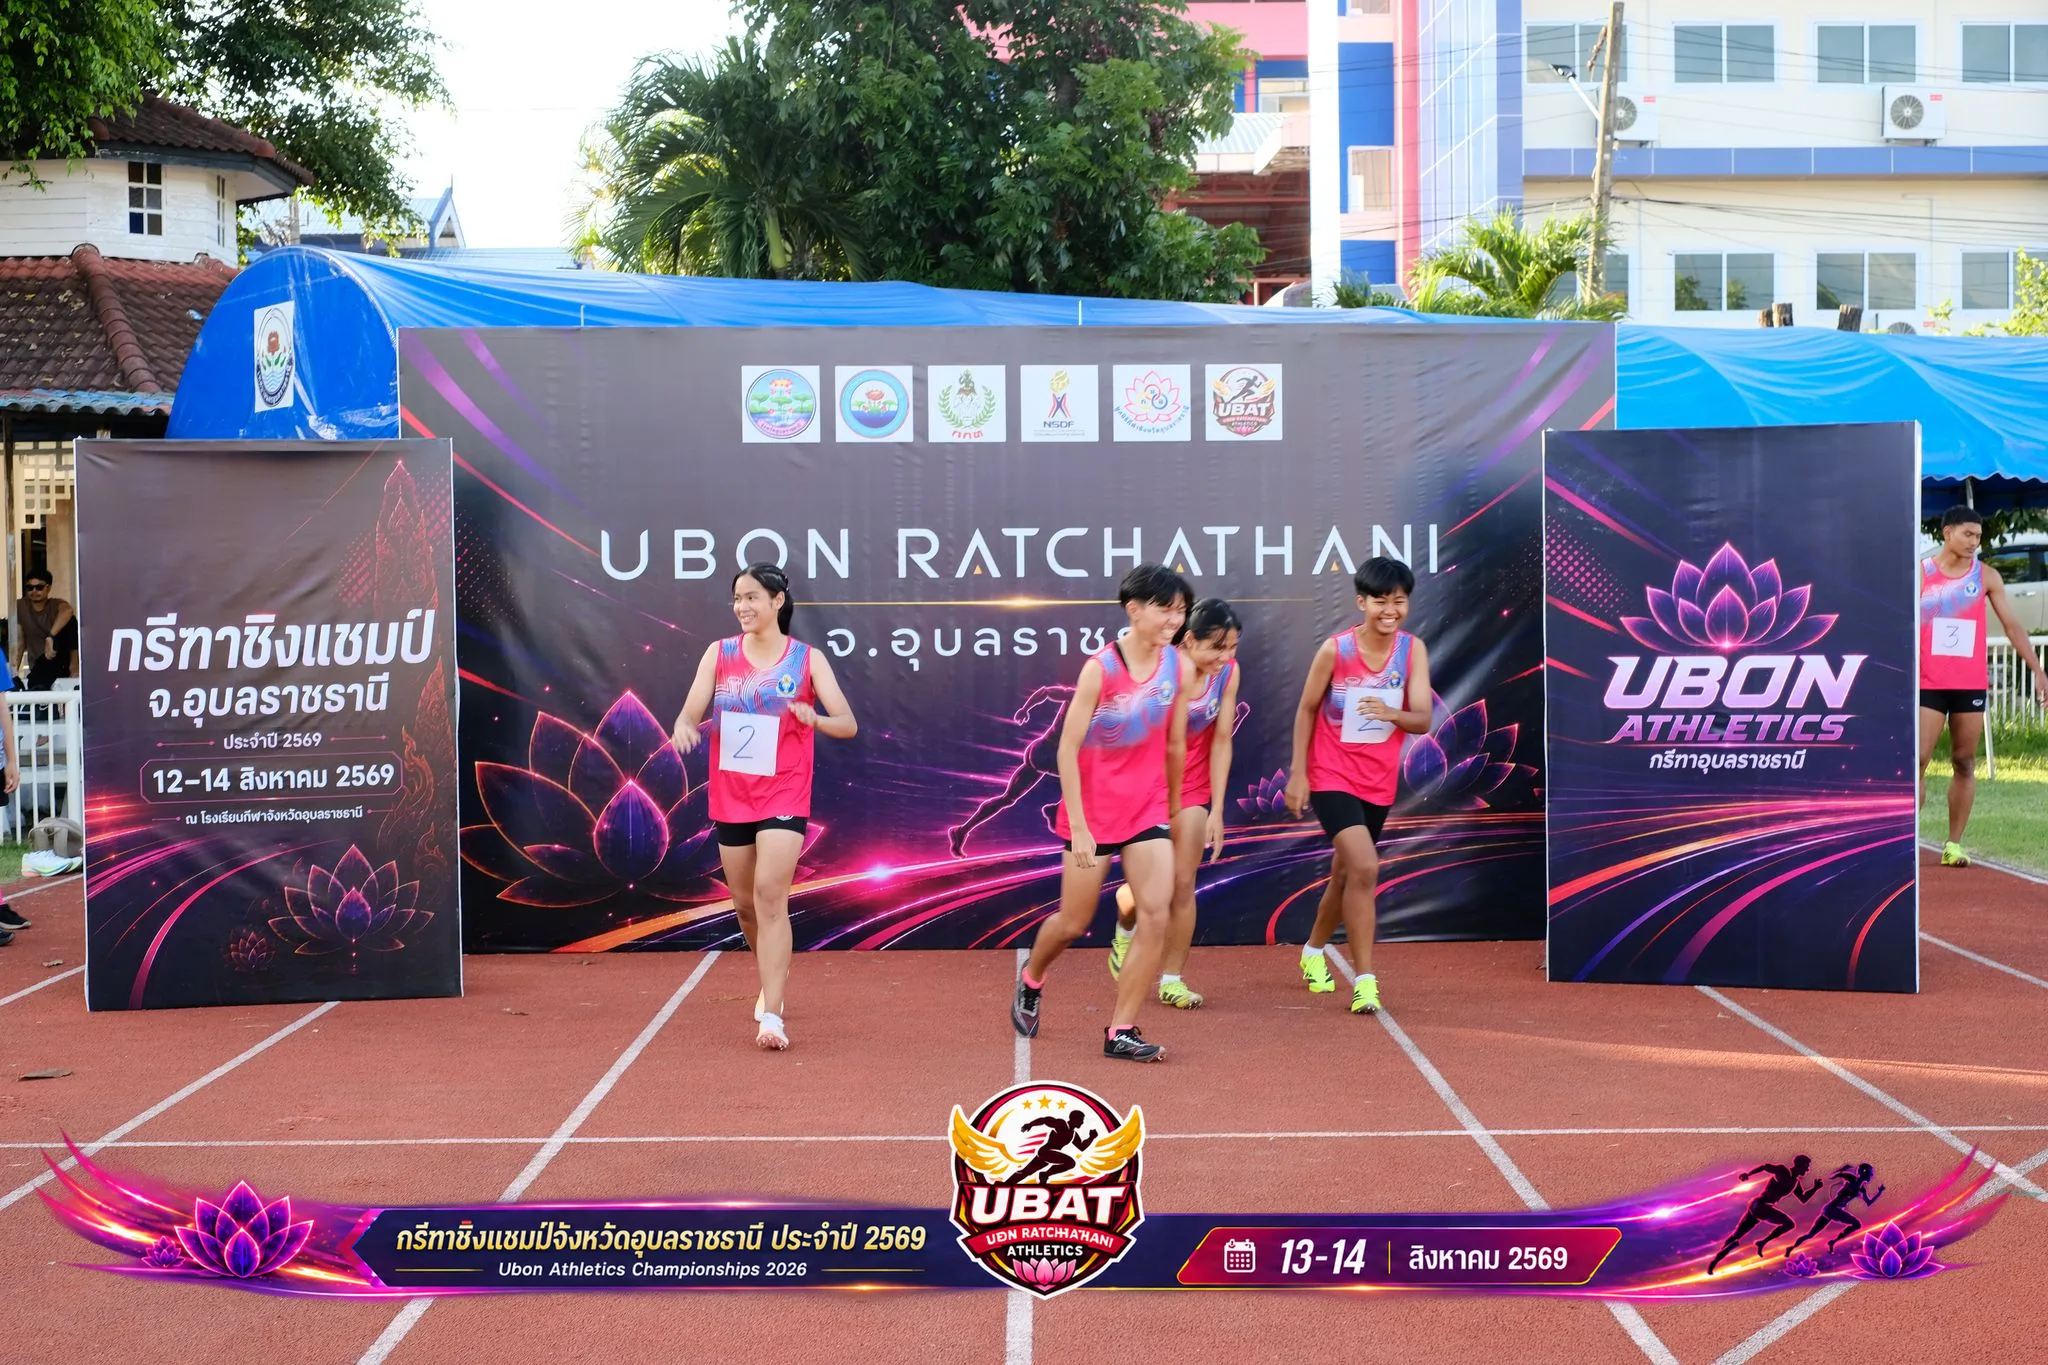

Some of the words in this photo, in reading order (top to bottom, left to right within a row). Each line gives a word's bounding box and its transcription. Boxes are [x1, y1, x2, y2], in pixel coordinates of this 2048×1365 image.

[1218, 402, 1271, 417] UBAT
[1043, 420, 1075, 429] NSDF
[601, 528, 849, 580] UBON
[898, 524, 1438, 578] RATCHATHANI
[108, 608, 436, 672] กรีฑาชิงแชมป์
[1946, 625, 1960, 648] 3
[1603, 654, 1869, 709] UBON
[149, 672, 390, 728] จ.อุบลราชธานี
[223, 731, 278, 750] ประจำปี
[283, 732, 322, 748] 2569
[732, 725, 756, 759] 2
[1603, 714, 1859, 743] ATHLETICS
[239, 766, 328, 791] สิงหาคม
[336, 763, 395, 787] 2569
[185, 814, 198, 825] ณ
